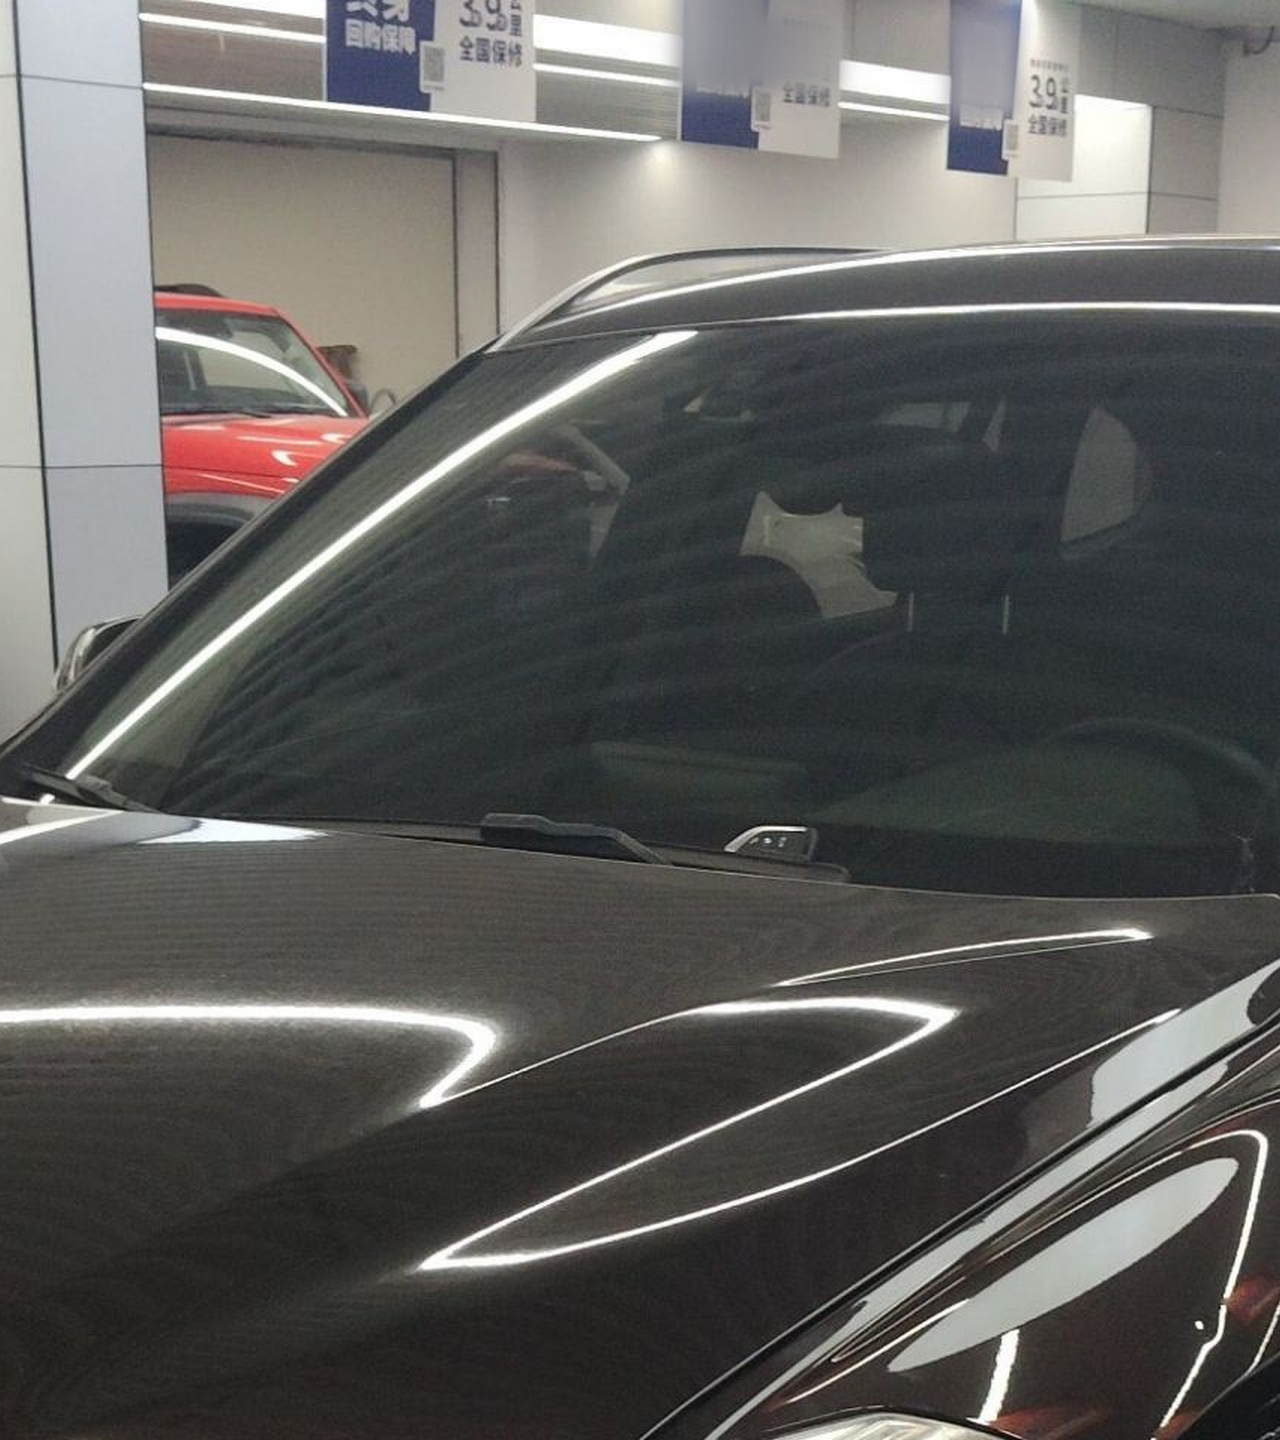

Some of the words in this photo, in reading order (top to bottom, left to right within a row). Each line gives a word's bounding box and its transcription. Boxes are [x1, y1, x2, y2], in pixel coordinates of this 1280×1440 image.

[345, 19, 416, 54] 回购保障
[458, 35, 523, 67] 全国保修
